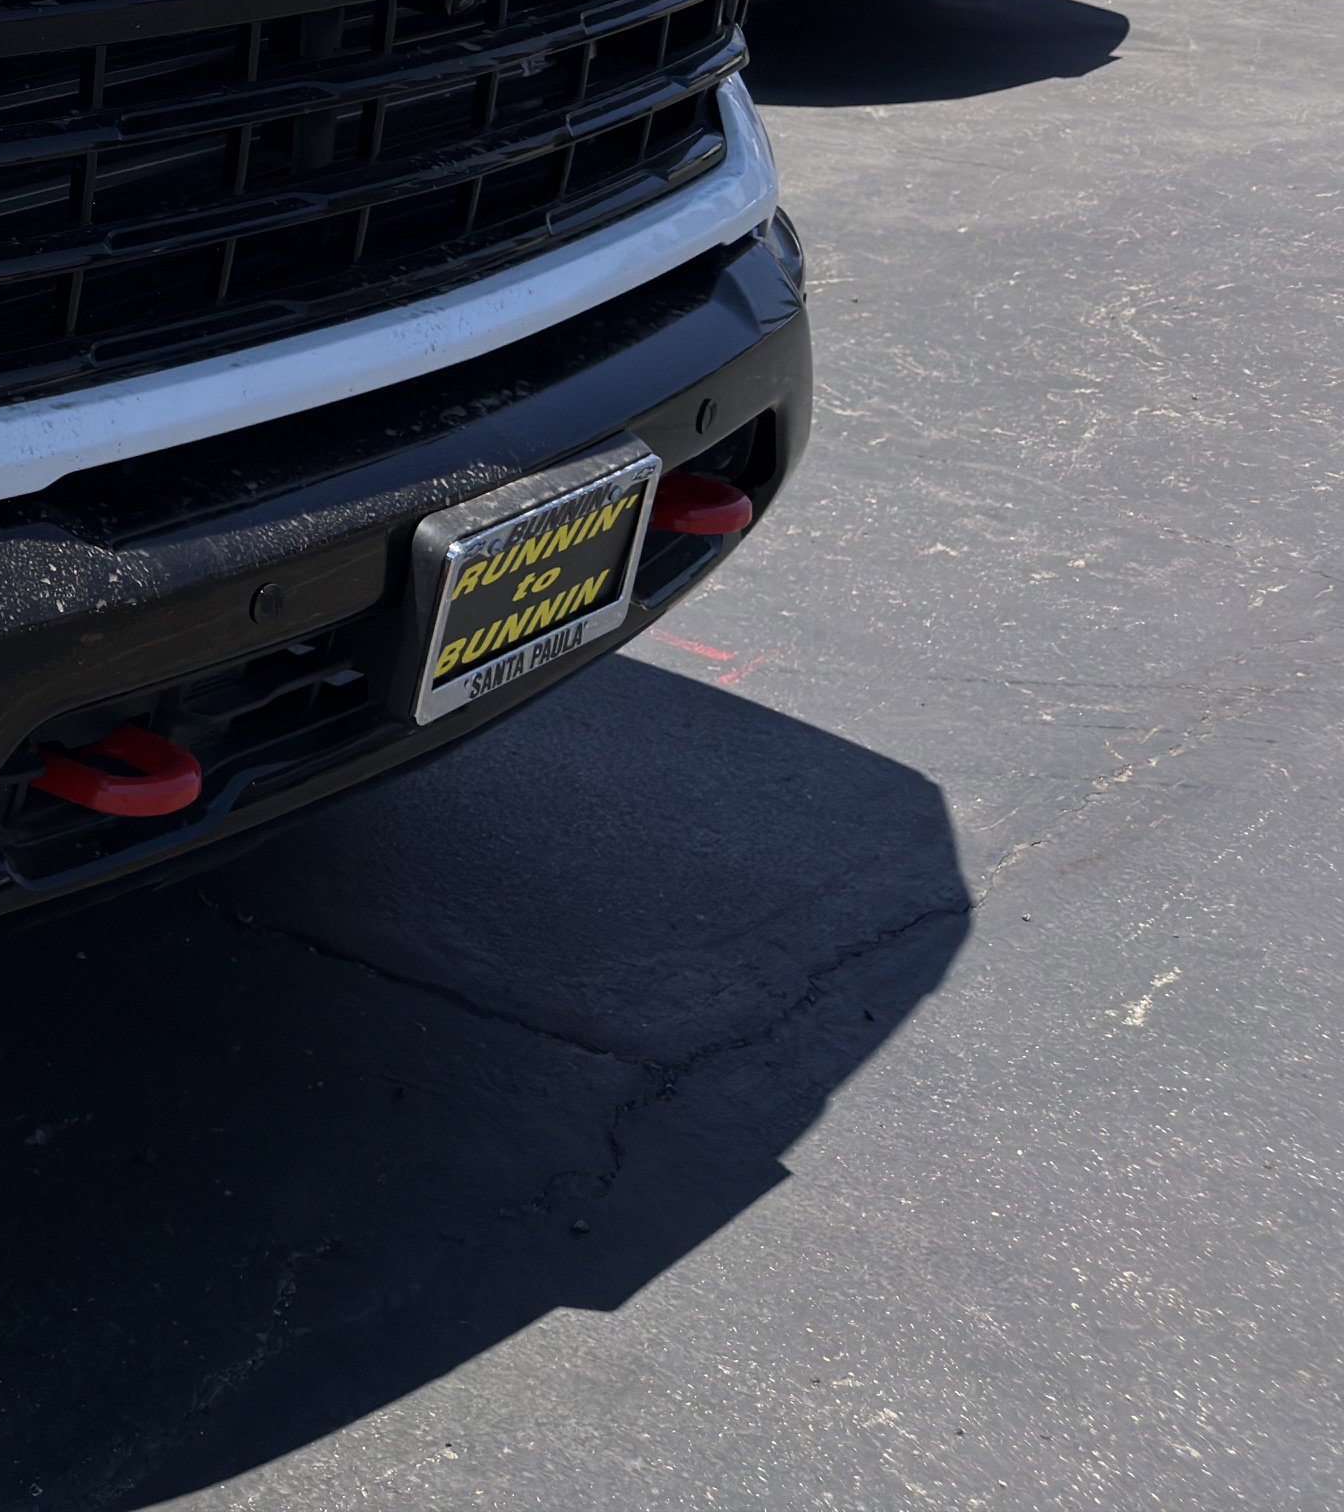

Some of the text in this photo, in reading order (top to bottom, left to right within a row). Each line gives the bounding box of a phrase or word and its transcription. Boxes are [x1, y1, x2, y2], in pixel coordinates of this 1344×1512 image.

[451, 494, 639, 601] RUNNIN'
[512, 566, 562, 602] to
[433, 569, 610, 679] BUNNIN
